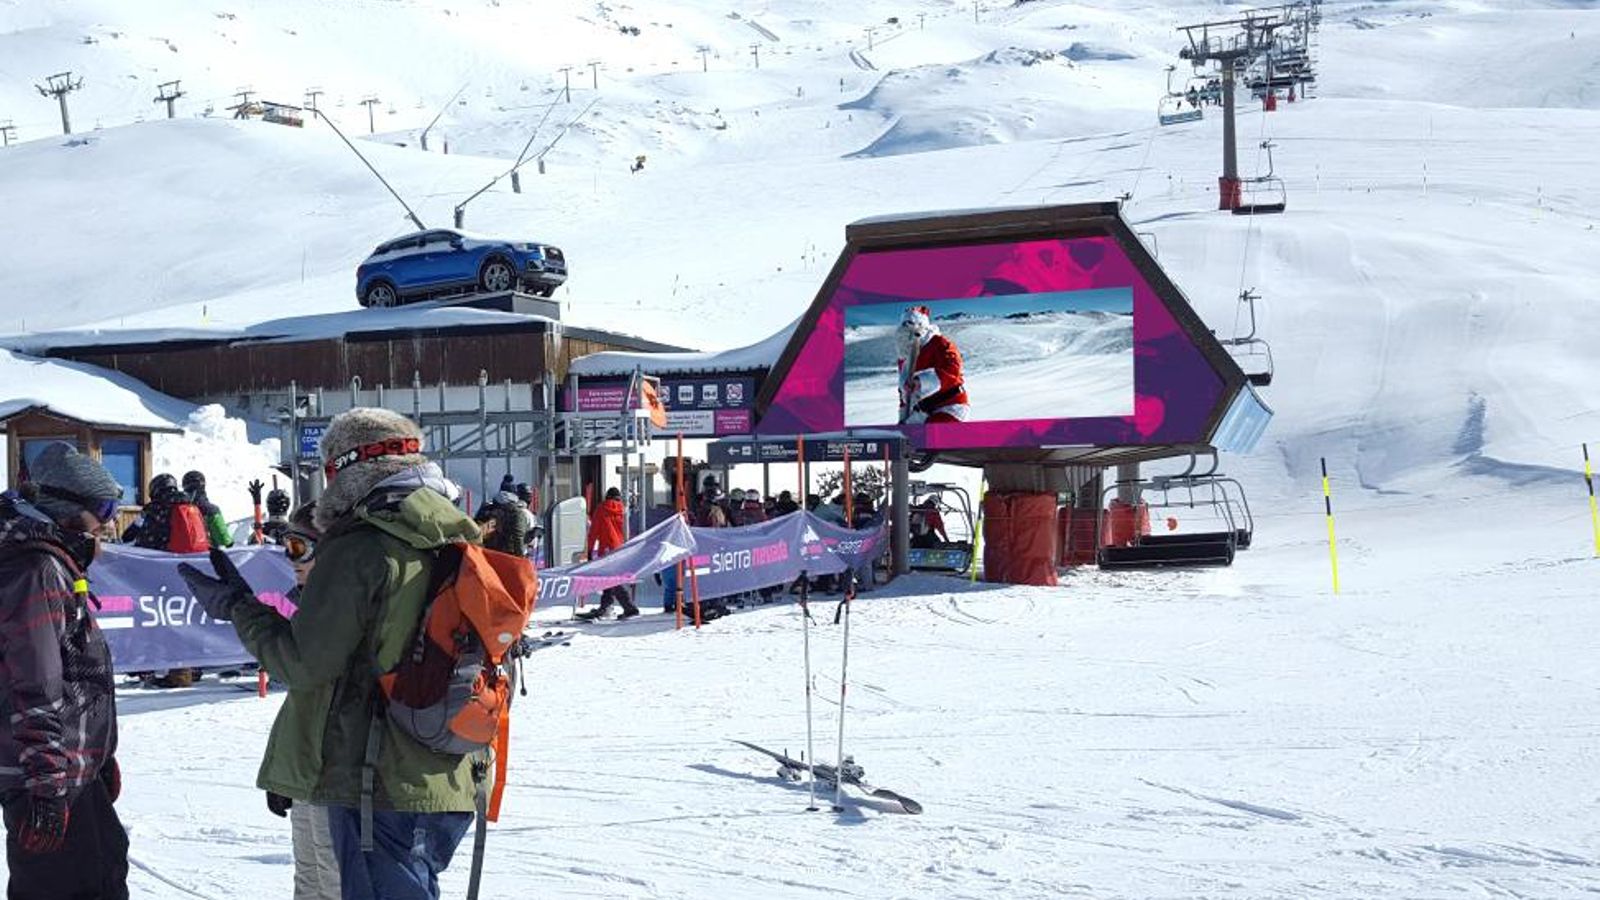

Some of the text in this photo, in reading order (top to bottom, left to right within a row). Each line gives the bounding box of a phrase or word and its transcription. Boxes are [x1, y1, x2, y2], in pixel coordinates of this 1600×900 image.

[712, 546, 750, 573] sierra
[752, 539, 788, 569] nevada
[537, 576, 571, 599] erra
[138, 586, 233, 627] sier
